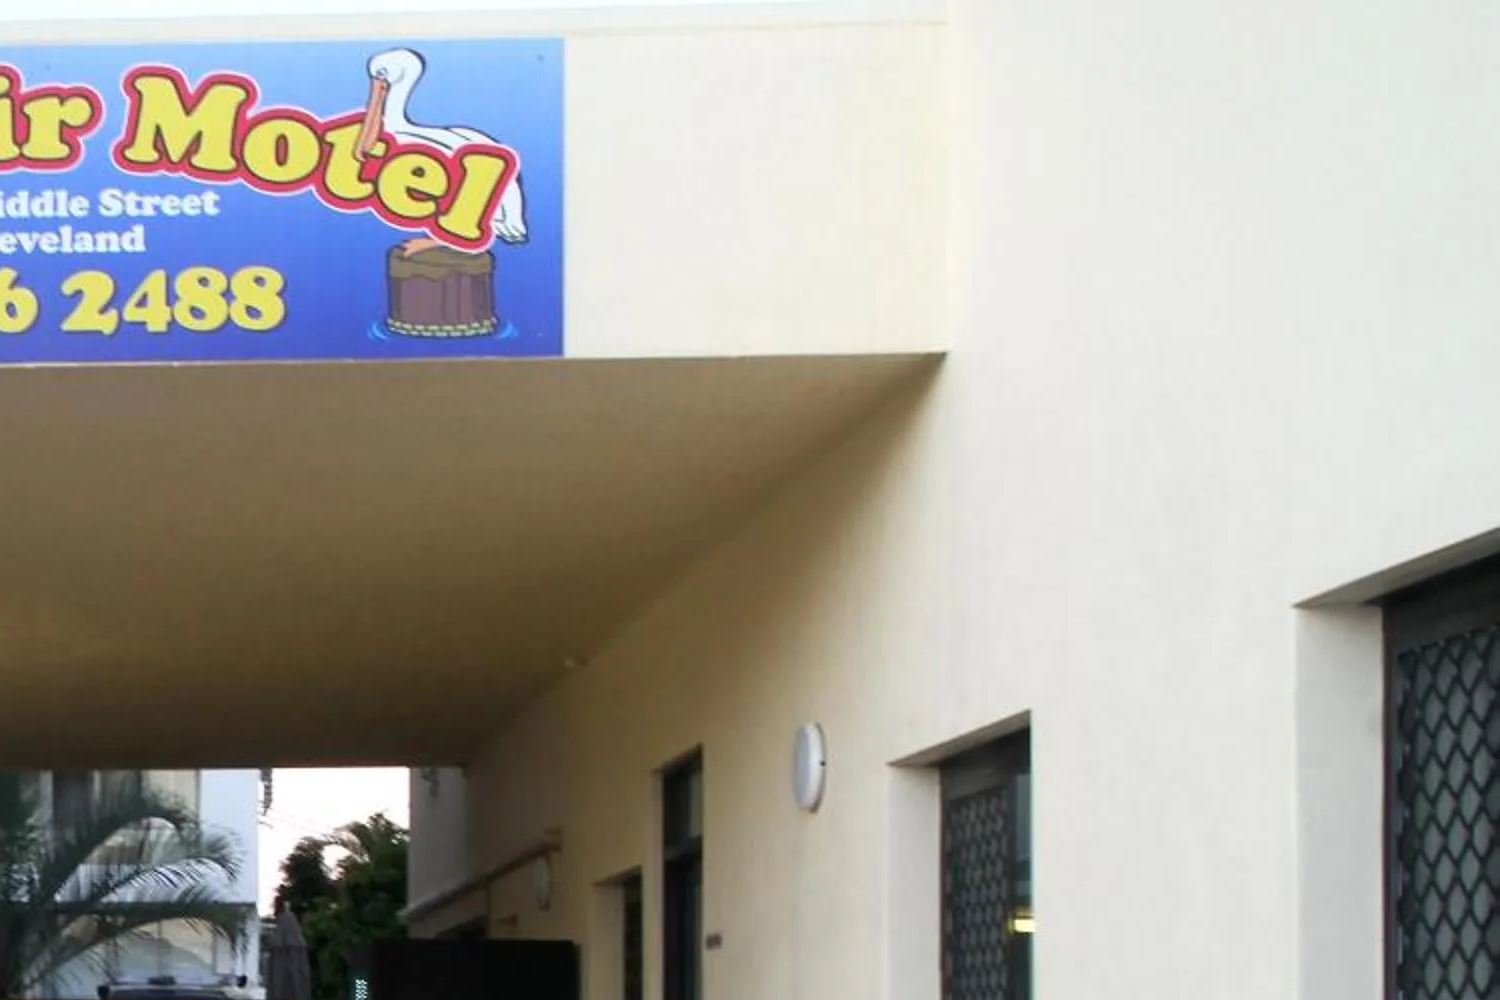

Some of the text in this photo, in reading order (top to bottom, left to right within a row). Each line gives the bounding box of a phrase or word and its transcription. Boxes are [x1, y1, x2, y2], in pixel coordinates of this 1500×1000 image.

[115, 68, 516, 246] Motel
[97, 189, 221, 217] Street
[60, 264, 288, 336] 2488
